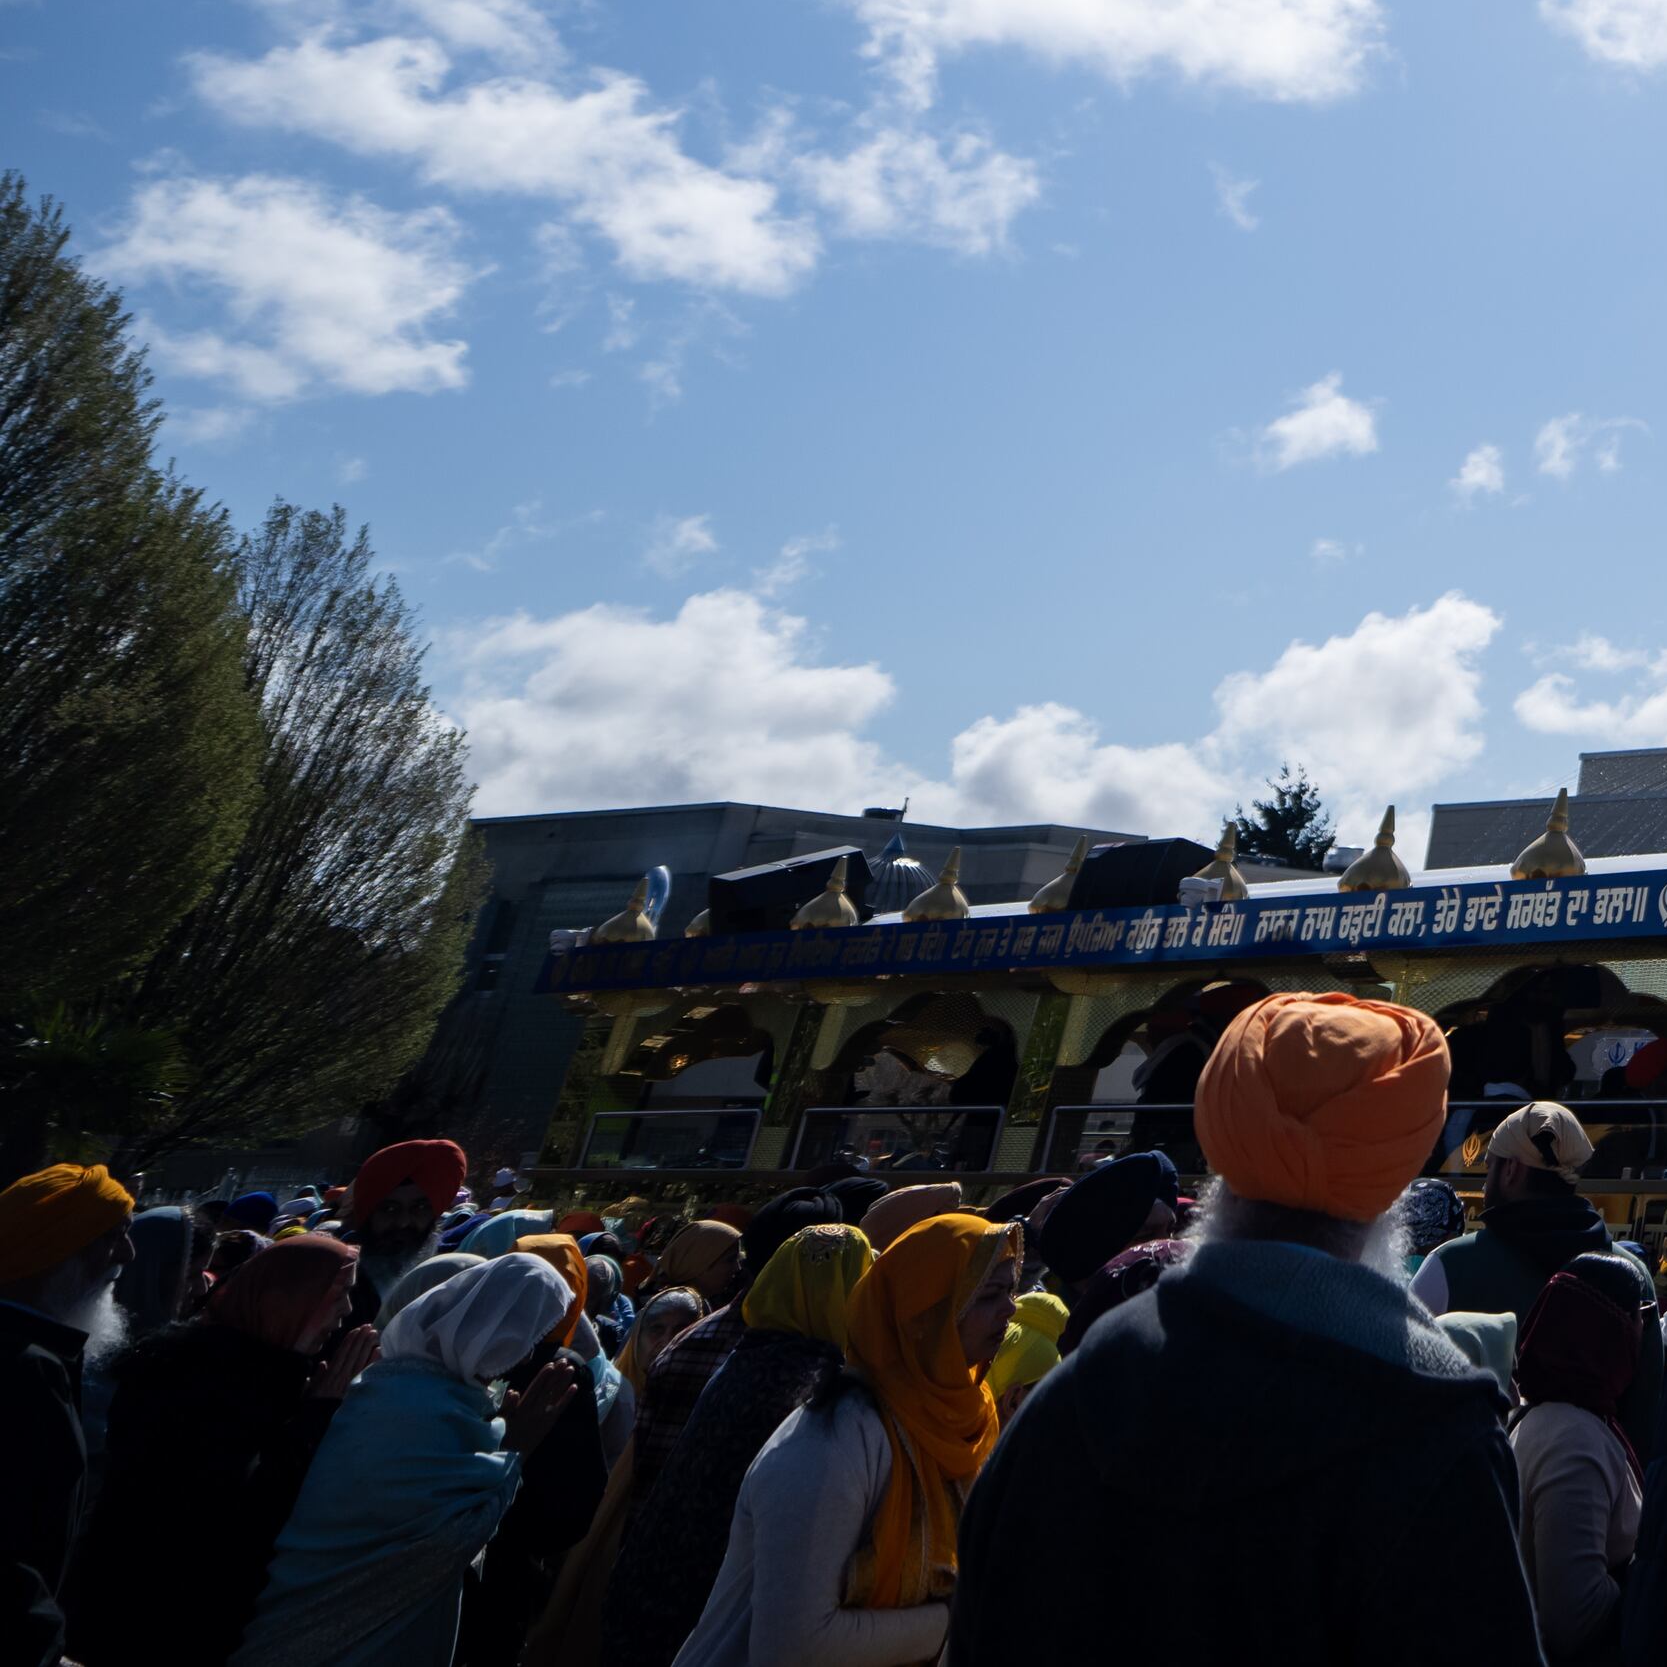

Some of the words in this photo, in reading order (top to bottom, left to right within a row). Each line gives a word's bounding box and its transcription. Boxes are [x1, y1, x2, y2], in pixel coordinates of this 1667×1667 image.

[1162, 908, 1192, 949] ਭਲੇ
[1301, 905, 1337, 941] ਨਾਮ
[1432, 887, 1461, 934] ਤੇਰੇ
[1463, 884, 1503, 932] ਭਾਣੇ
[1565, 889, 1590, 926] ਦਾ
